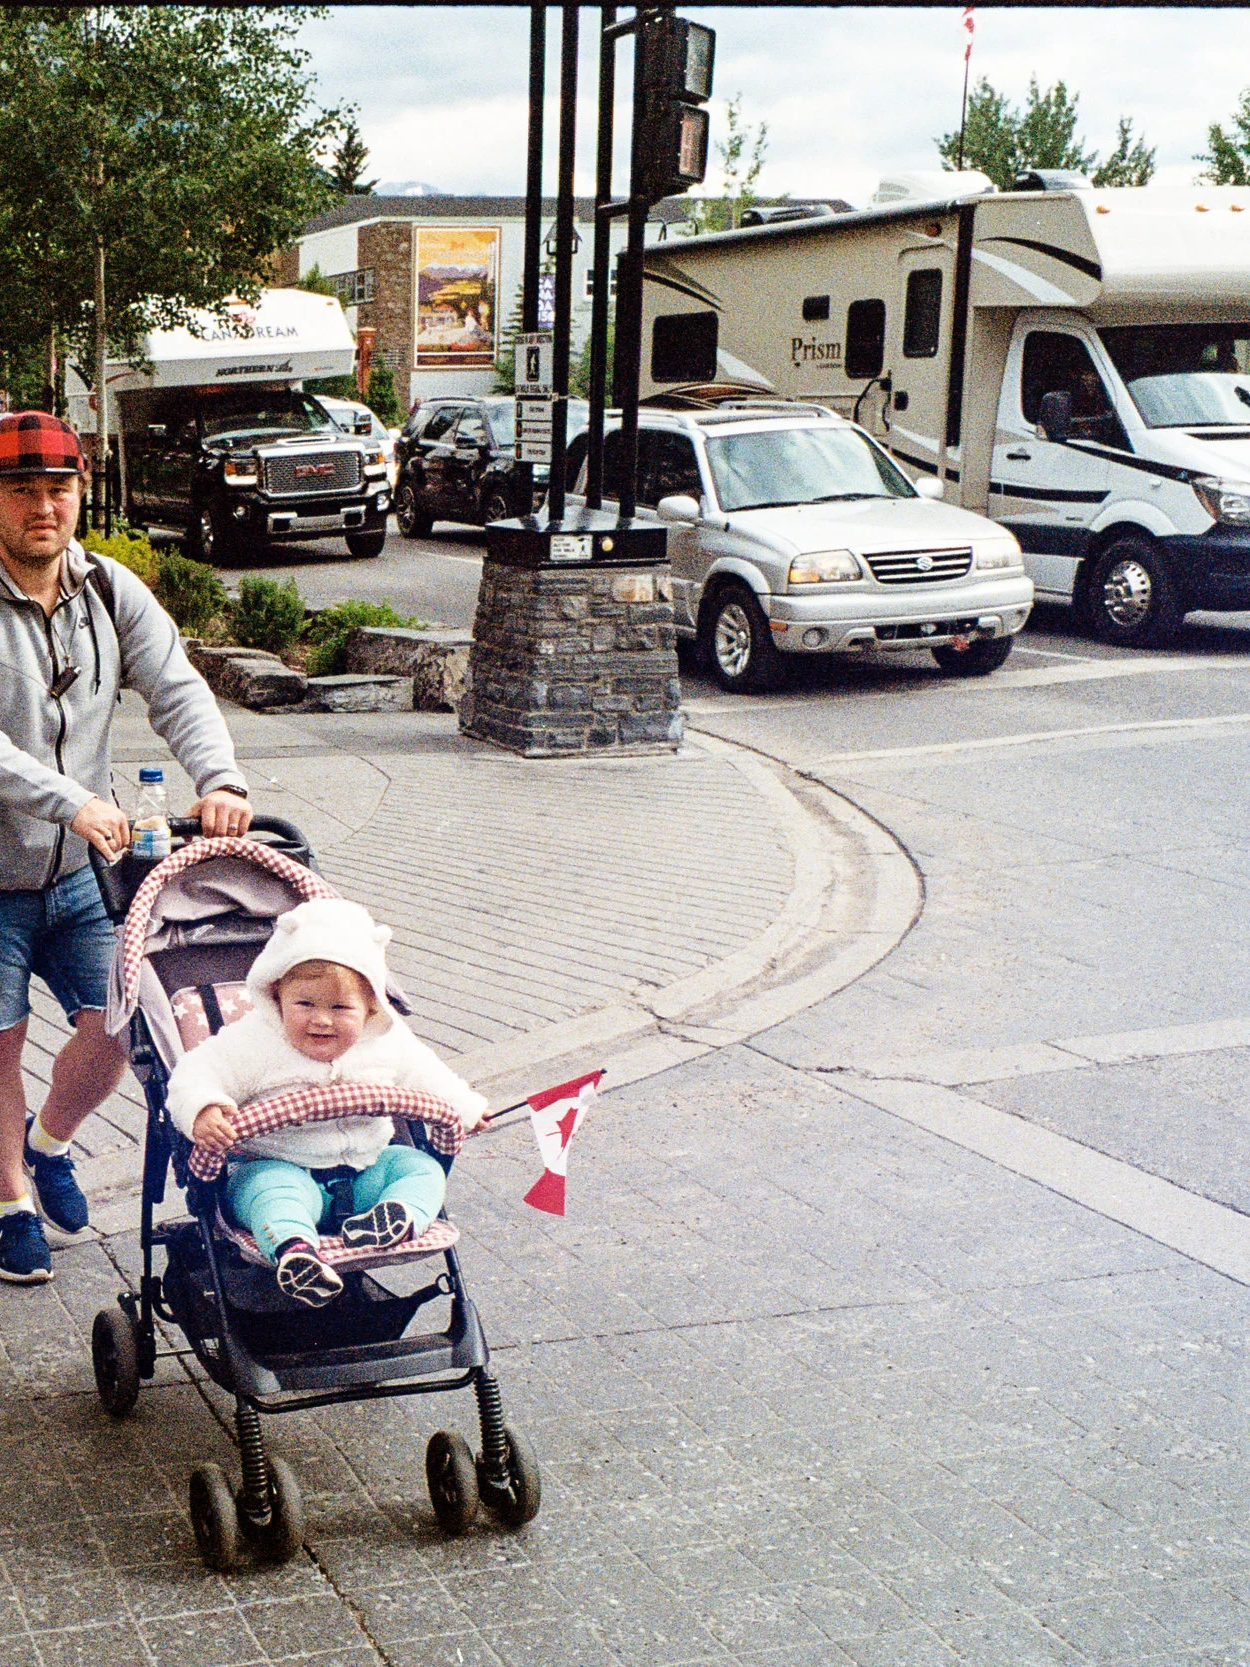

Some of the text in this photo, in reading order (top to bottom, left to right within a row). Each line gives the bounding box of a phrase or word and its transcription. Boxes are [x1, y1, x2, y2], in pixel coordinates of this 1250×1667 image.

[201, 326, 298, 342] CANDREAM
[791, 336, 841, 360] Prism
[295, 463, 335, 477] GMC
